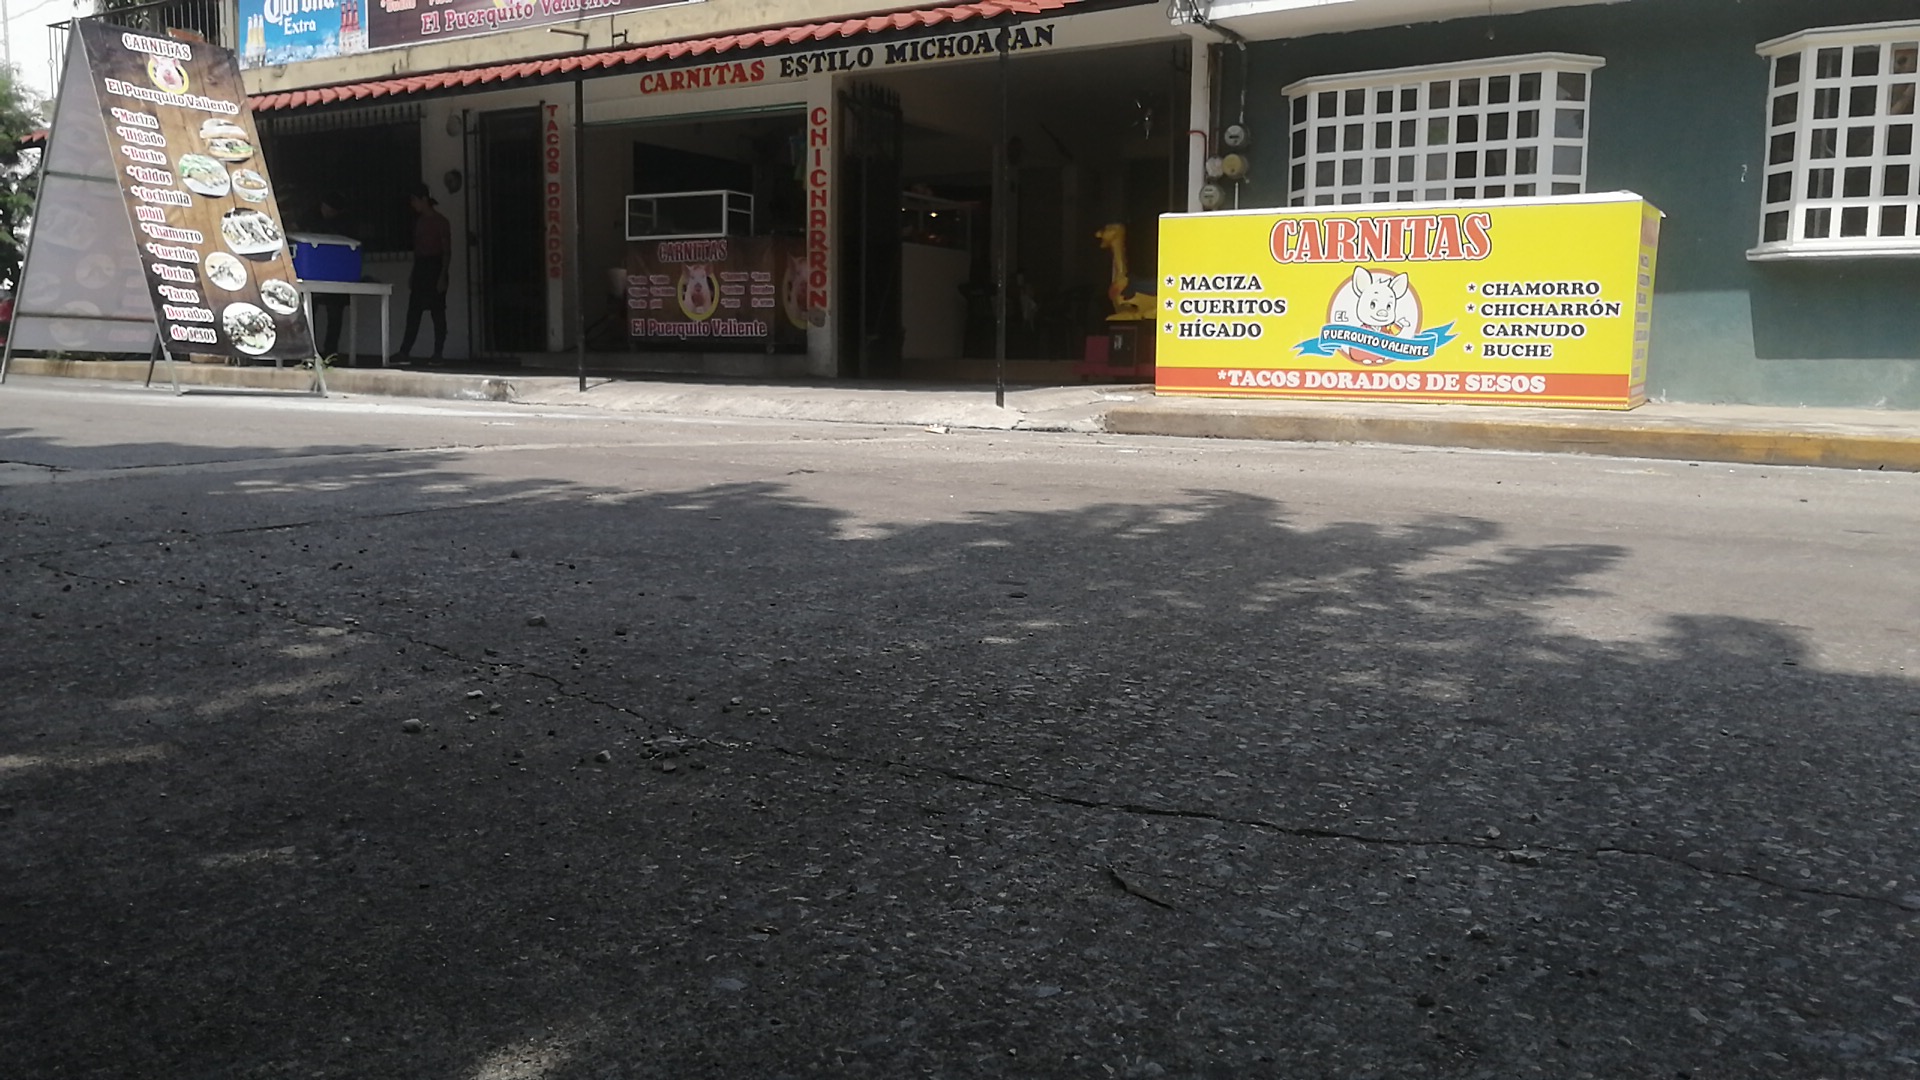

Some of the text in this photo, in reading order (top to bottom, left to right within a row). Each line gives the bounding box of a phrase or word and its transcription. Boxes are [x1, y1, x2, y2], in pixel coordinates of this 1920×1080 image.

[284, 17, 316, 35] Extra
[422, 12, 440, 34] El
[445, 5, 534, 31] Puerquito
[122, 33, 191, 61] CARNITAS
[640, 60, 765, 94] CARNITAS
[780, 47, 873, 78] ESTILO
[105, 78, 238, 114] El Puerquito Valiente
[546, 104, 562, 278] TACOS DORADOS
[1270, 212, 1492, 264] CARNITAS
[658, 240, 727, 262] CARNITAS
[1180, 275, 1262, 290] MACIZA
[1482, 282, 1600, 296] CHAMORRO
[163, 304, 213, 322] Dorados
[1179, 299, 1286, 314] CUERITOS
[1335, 310, 1349, 322] EL
[1481, 299, 1620, 316] CHICHARRÓN
[170, 324, 217, 343] de sesos
[631, 317, 768, 340] El Puerquito Valiente
[1178, 318, 1262, 338] HÍGADO
[1482, 324, 1585, 337] CARNUDO
[1323, 329, 1429, 356] PUERQUITO VALIENTE
[1483, 344, 1552, 357] BUCHE
[1304, 371, 1421, 390] DORADOS
[1426, 373, 1460, 391] DE
[1465, 374, 1546, 392] SESOS
